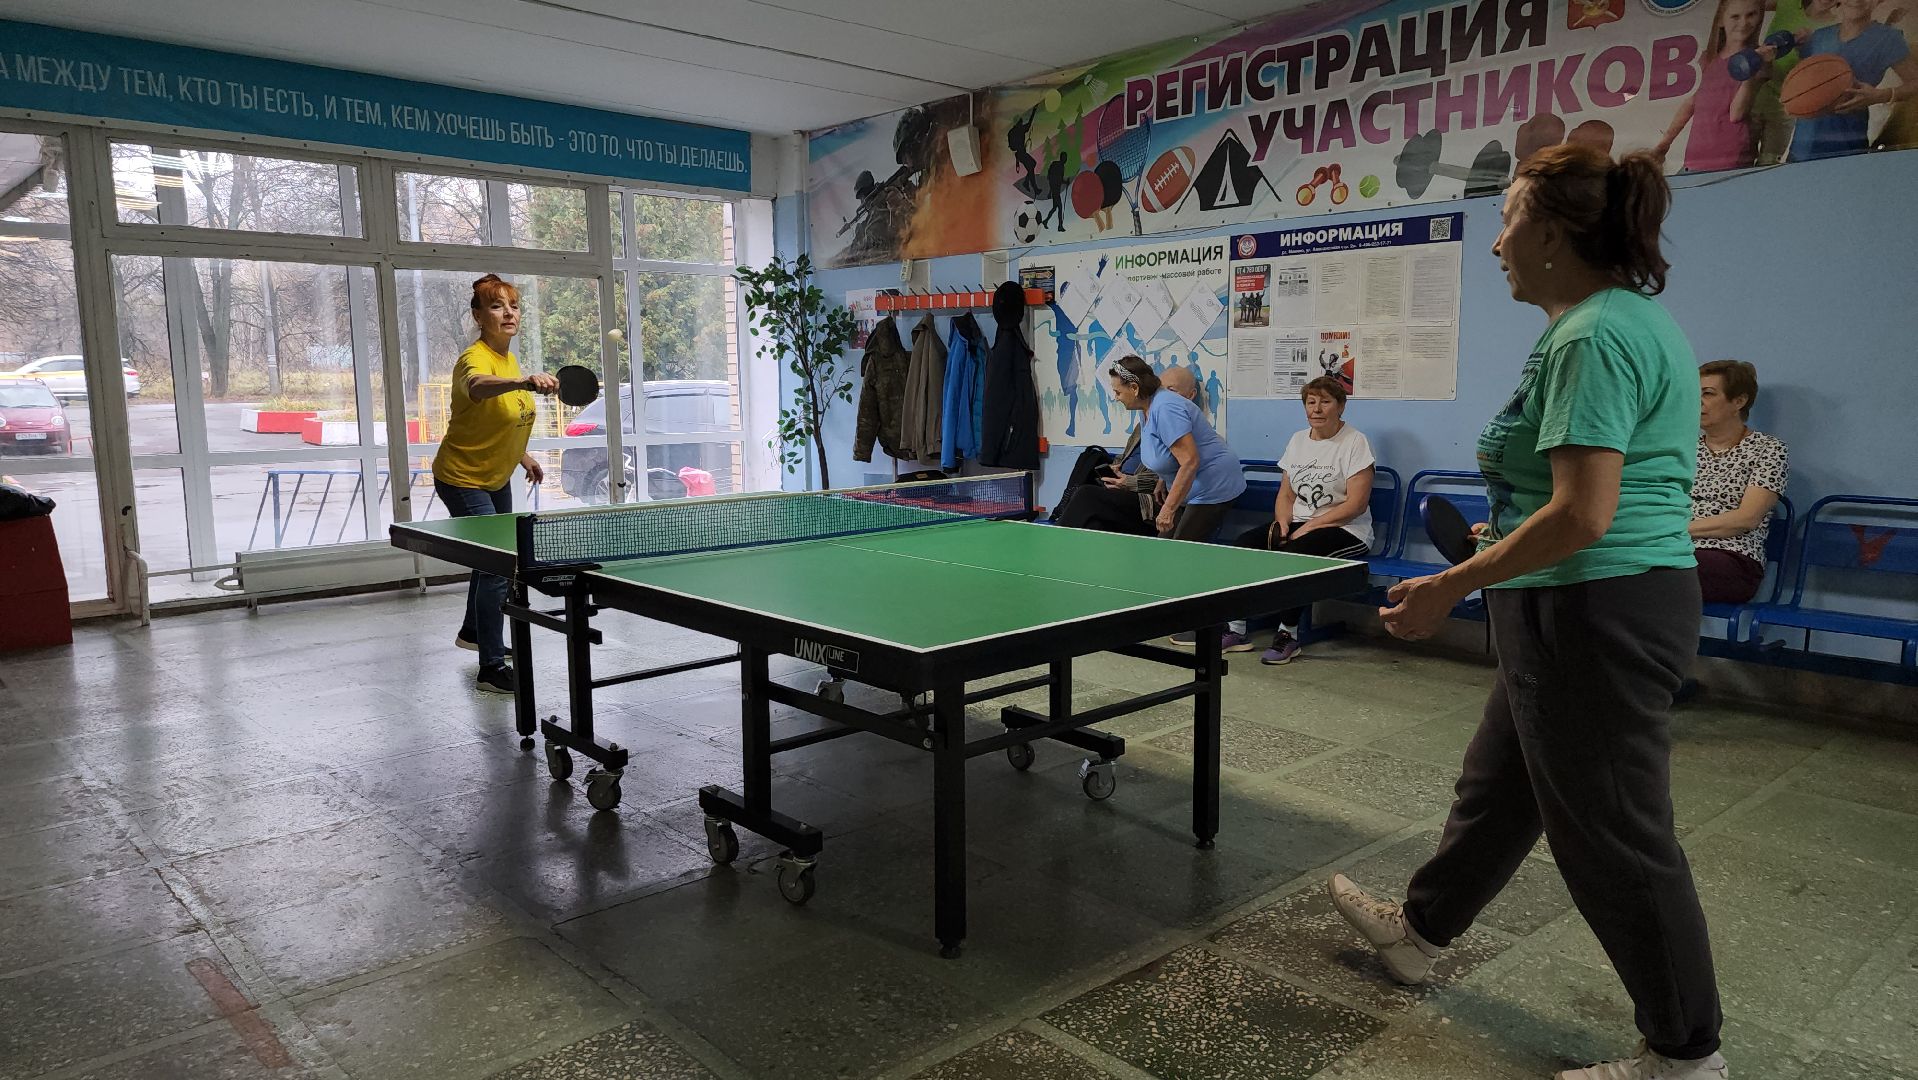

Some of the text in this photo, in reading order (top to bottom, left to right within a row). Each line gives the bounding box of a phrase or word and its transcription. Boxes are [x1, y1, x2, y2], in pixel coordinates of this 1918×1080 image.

[1125, 0, 1548, 126] РЕГИСТРАЦИЯ
[1248, 34, 1699, 162] УЧАСТНИКОВ
[16, 53, 111, 94] МЕЖДУ
[118, 67, 173, 101] ТЕМ,
[178, 74, 221, 106] КТО
[226, 81, 258, 111] ТЫ
[263, 86, 319, 120] ЕСТЬ,
[324, 94, 337, 120] И
[341, 97, 387, 130] ТЕМ,
[391, 104, 430, 132] КЕМ
[434, 110, 505, 142] ХОЧЕШЬ
[510, 121, 555, 149] БЫТЬ
[568, 129, 596, 153] ЭТО
[600, 134, 622, 159] ТО,
[626, 138, 654, 162] ЧТО
[655, 142, 677, 165] ТЫ
[680, 145, 748, 173] ДЕЛАЕШЬ.
[1115, 245, 1224, 271] ИНФОРМАЦИЯ
[1279, 222, 1403, 247] ИНФОРМАЦИЯ
[794, 637, 845, 664] UNIX LINE
